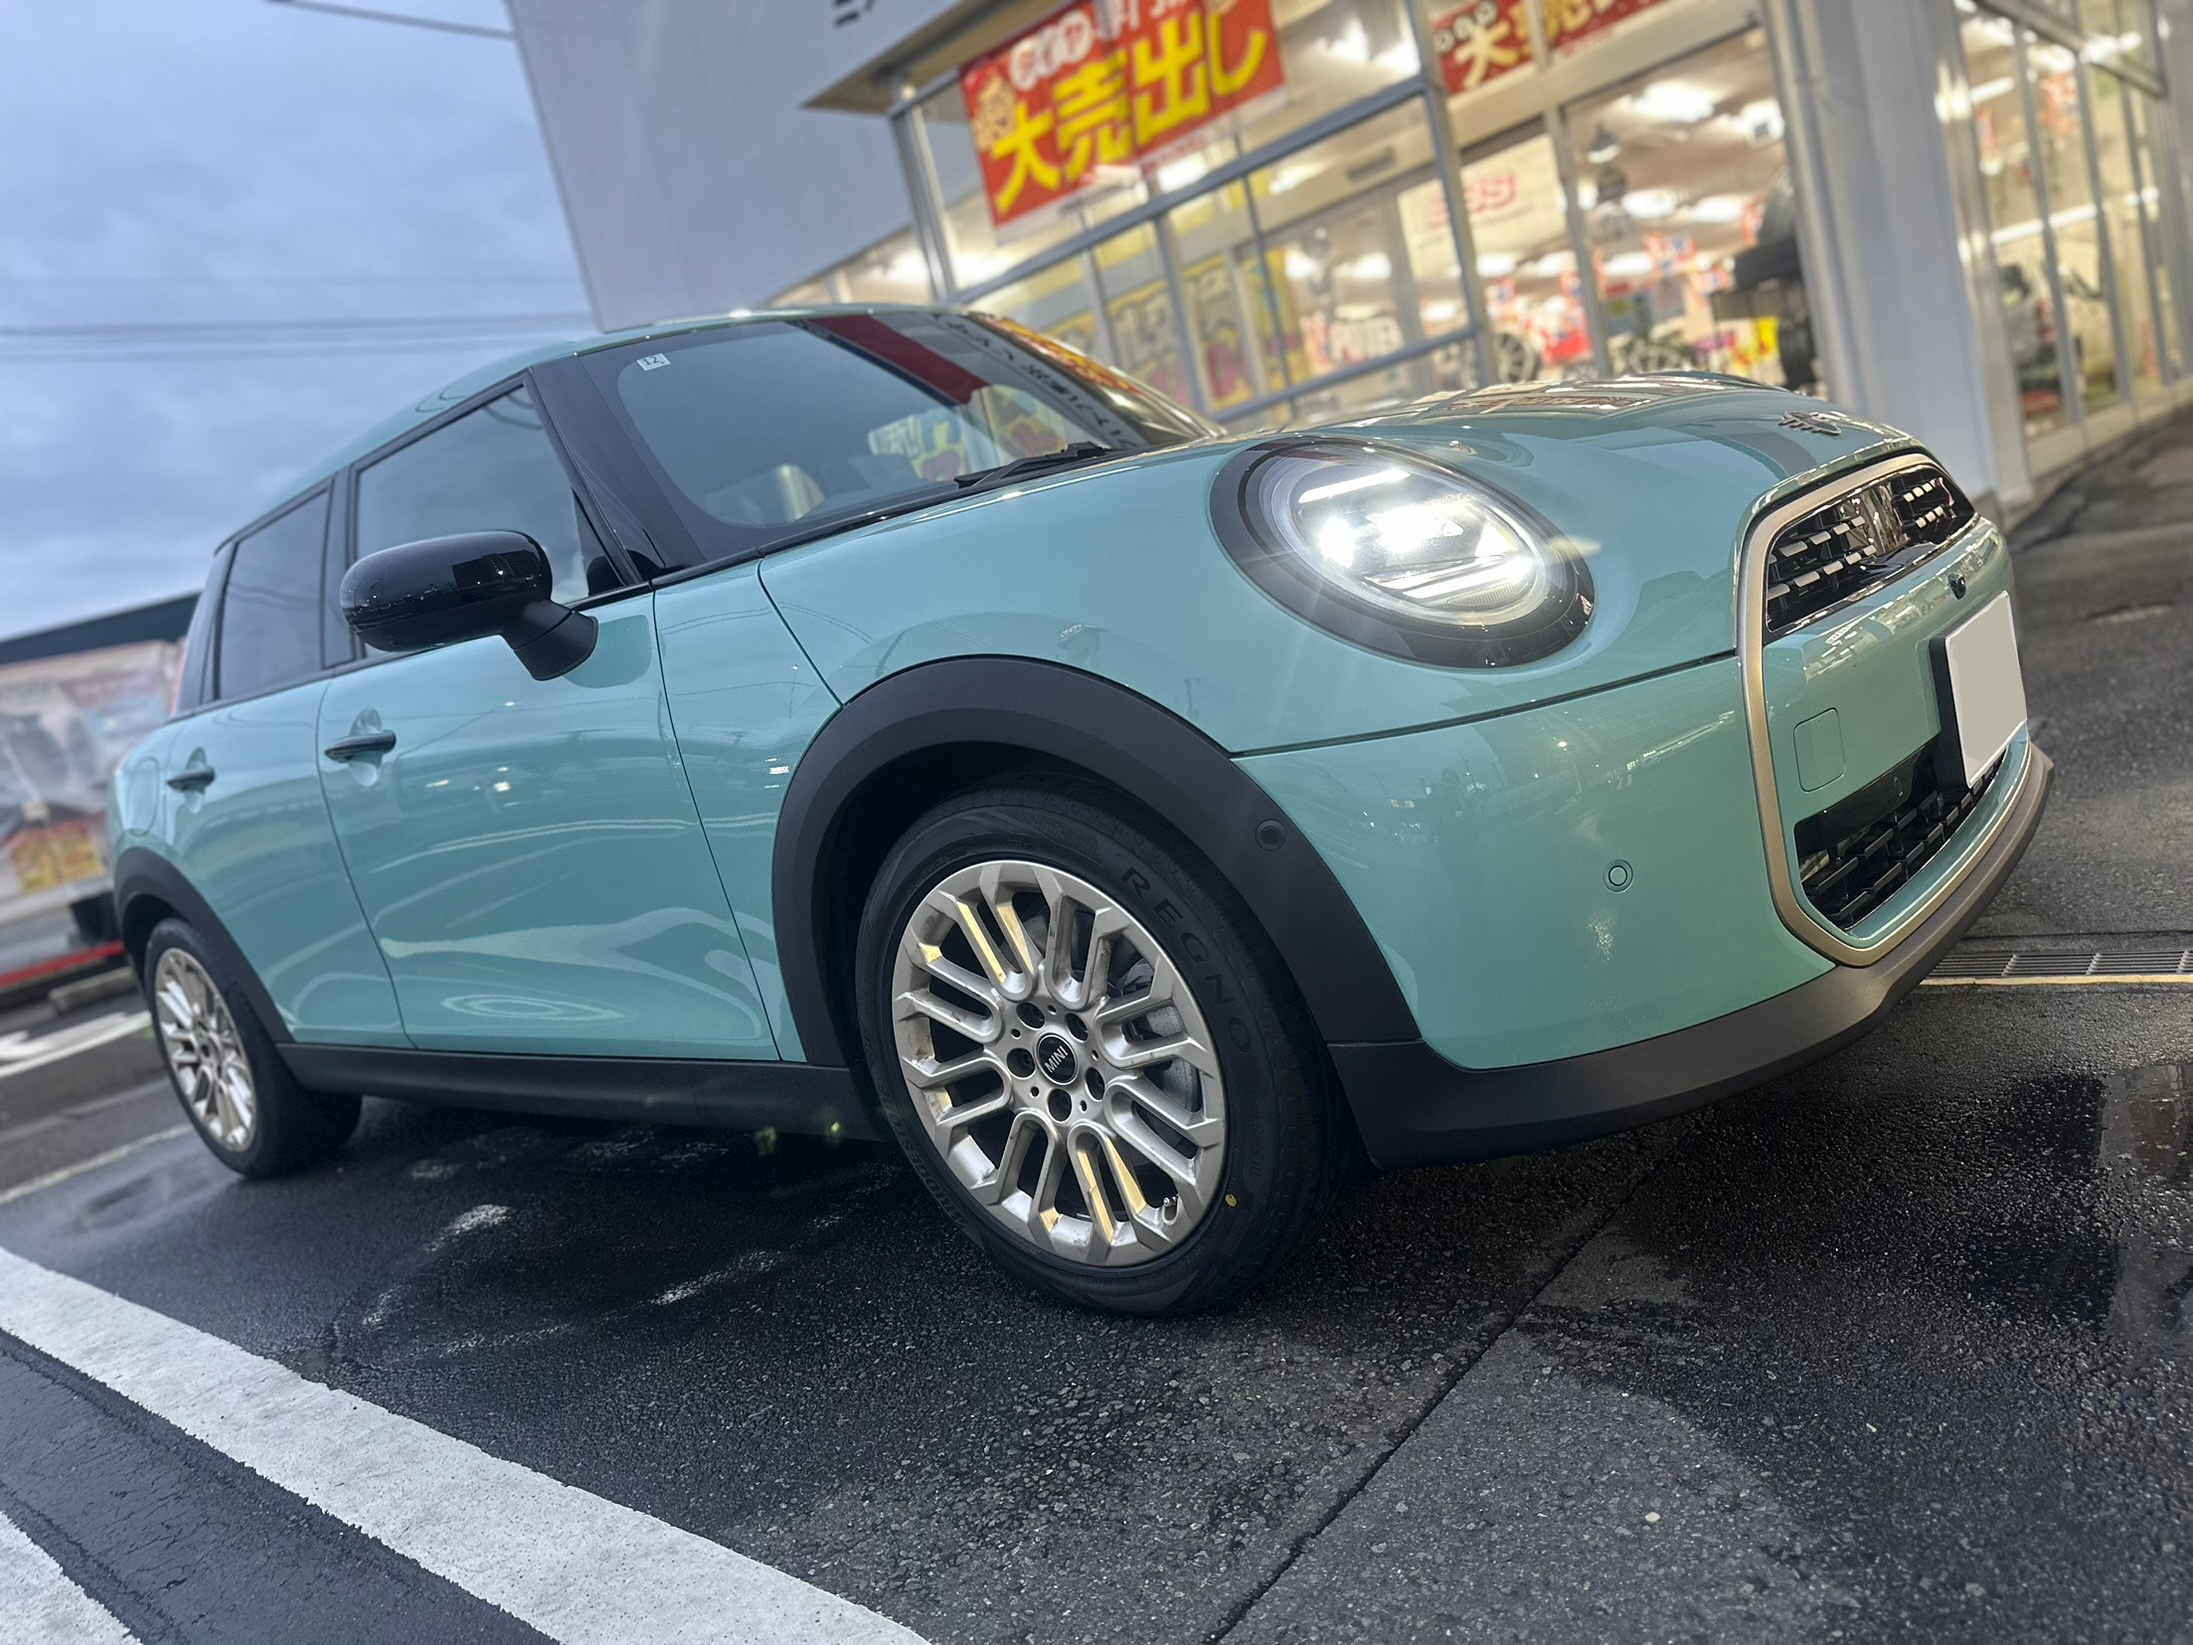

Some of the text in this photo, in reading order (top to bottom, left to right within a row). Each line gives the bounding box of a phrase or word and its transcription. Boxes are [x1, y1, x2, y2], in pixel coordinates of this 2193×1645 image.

[992, 11, 1266, 214] 大売出し
[1120, 866, 1252, 1054] REGNO
[1044, 1045, 1069, 1074] MINI
